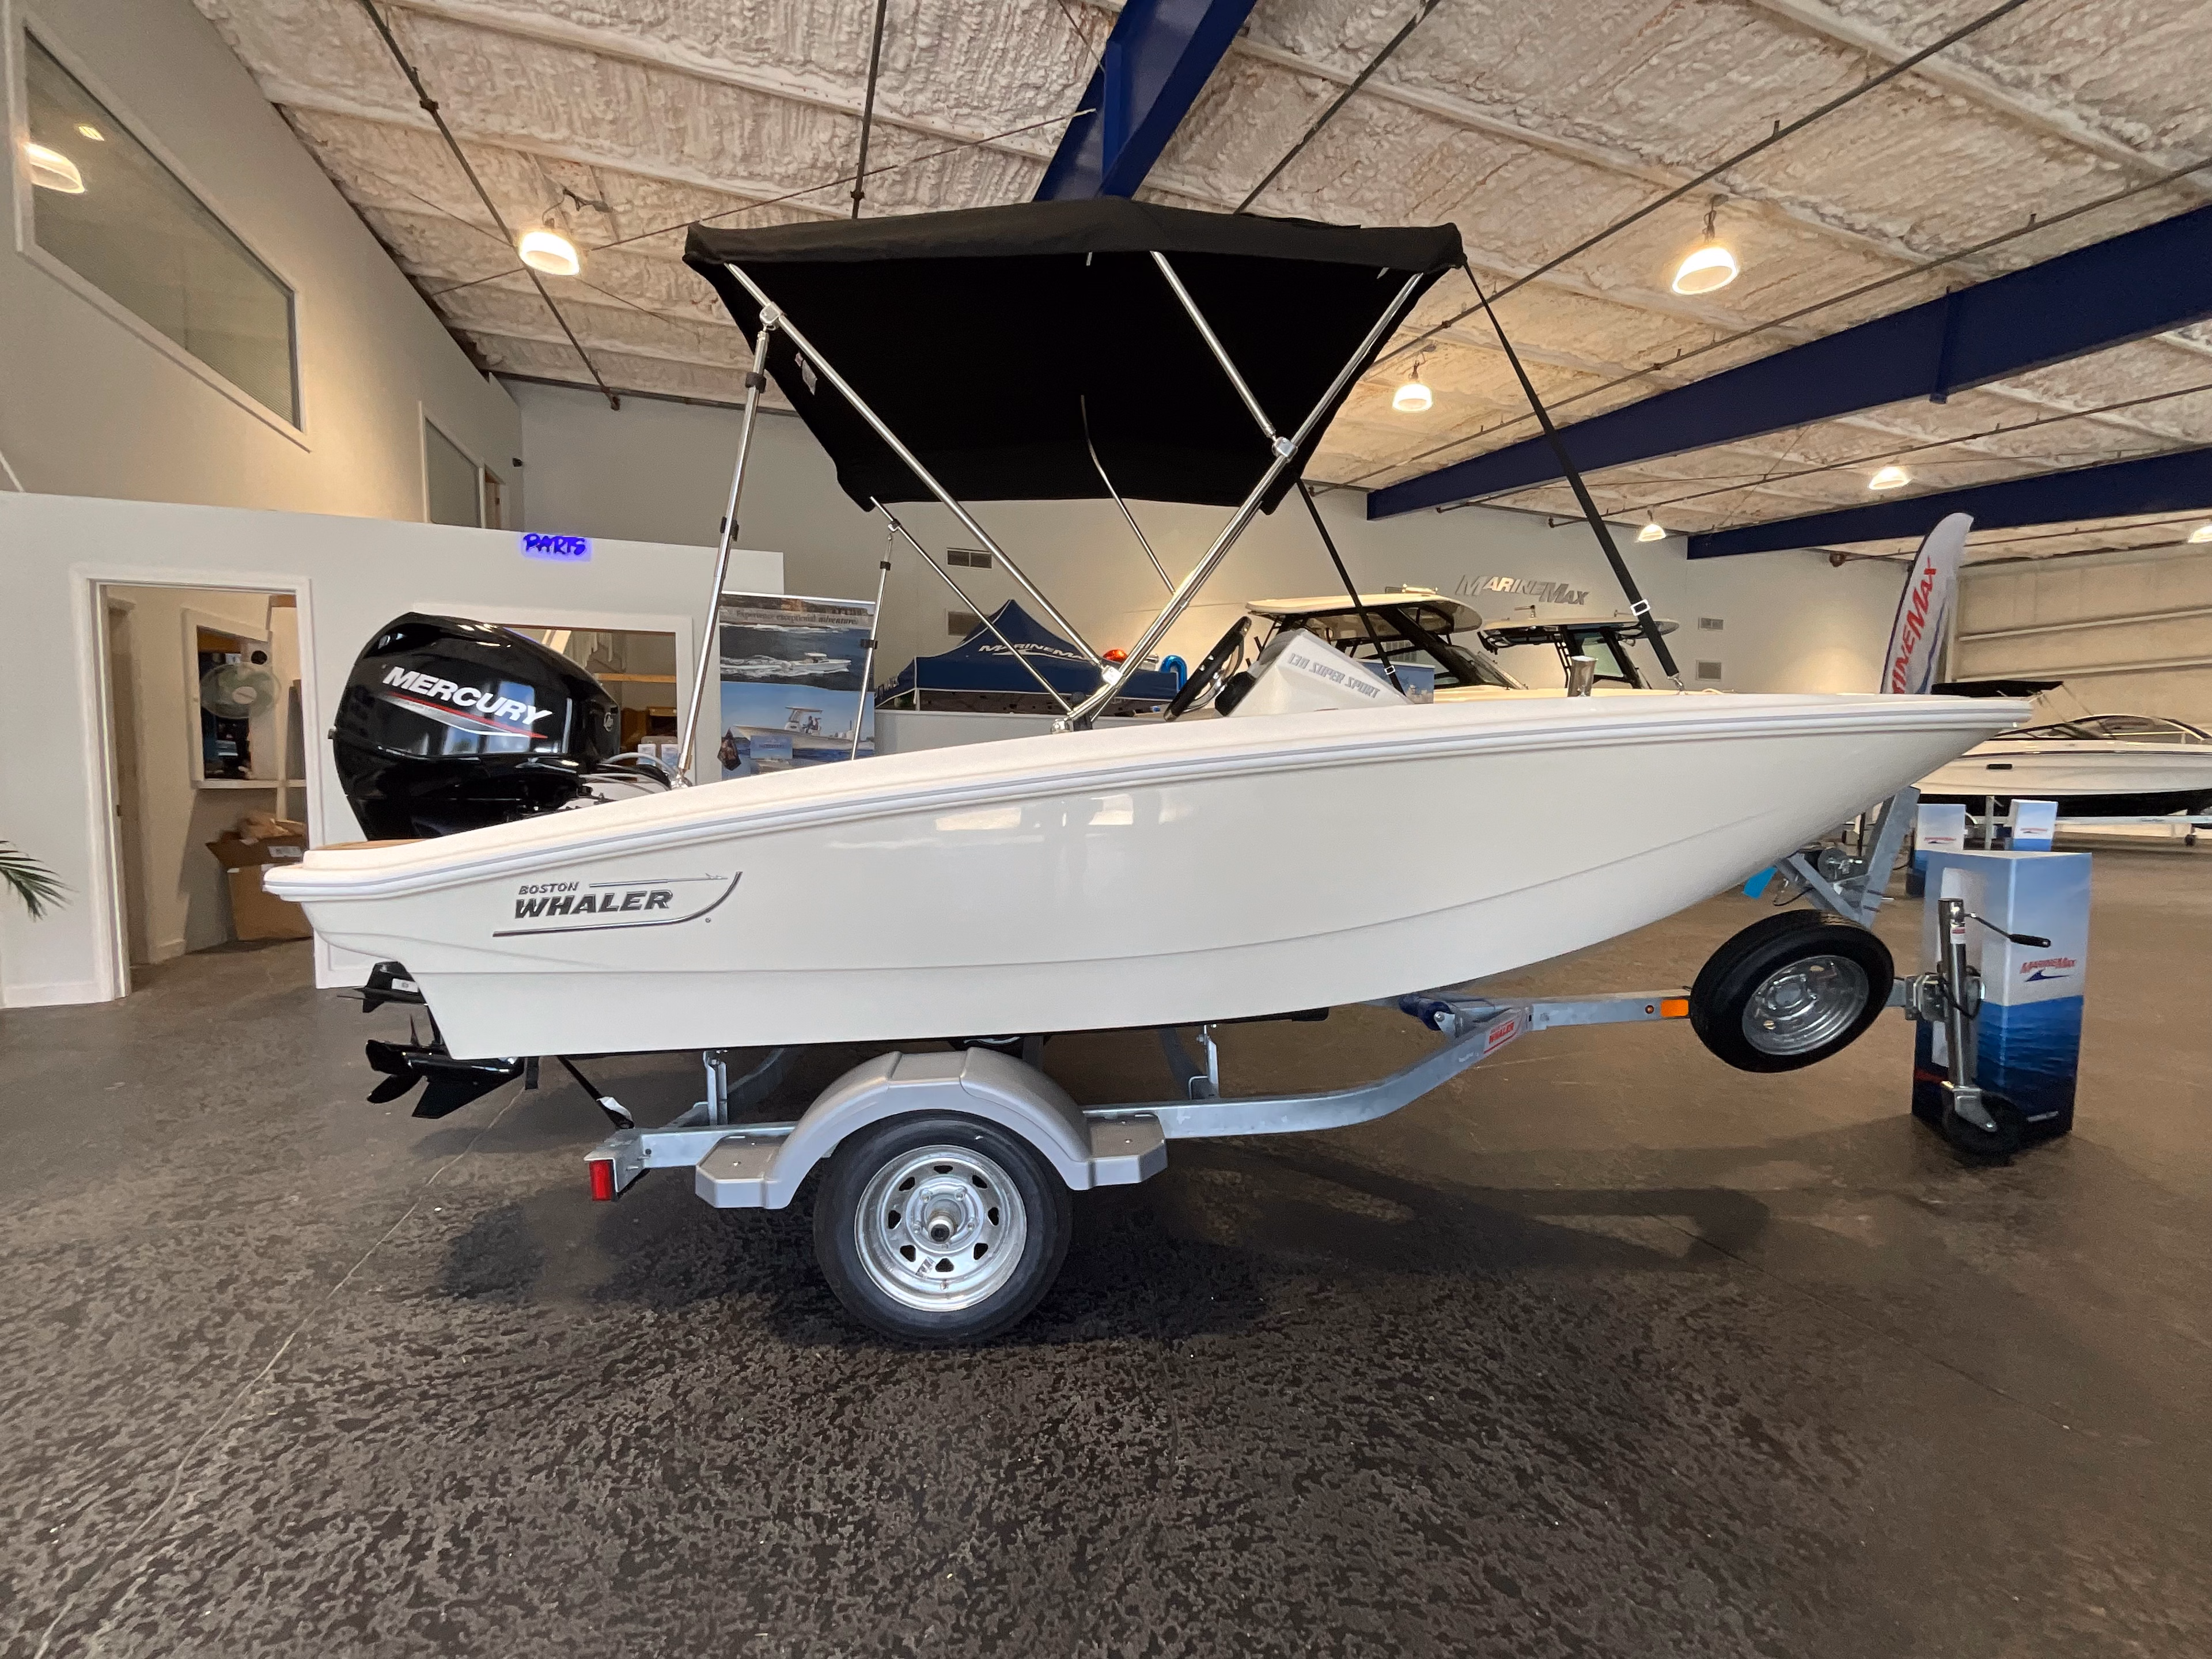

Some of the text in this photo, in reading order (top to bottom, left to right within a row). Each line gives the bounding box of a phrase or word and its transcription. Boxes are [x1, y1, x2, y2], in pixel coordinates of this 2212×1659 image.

[523, 533, 586, 555] PARTS
[1309, 662, 1346, 684] SUPER
[1344, 676, 1381, 699] SPORT
[382, 666, 553, 726] MERCURY
[518, 881, 579, 895] BOSTON
[515, 889, 673, 919] WHALER
